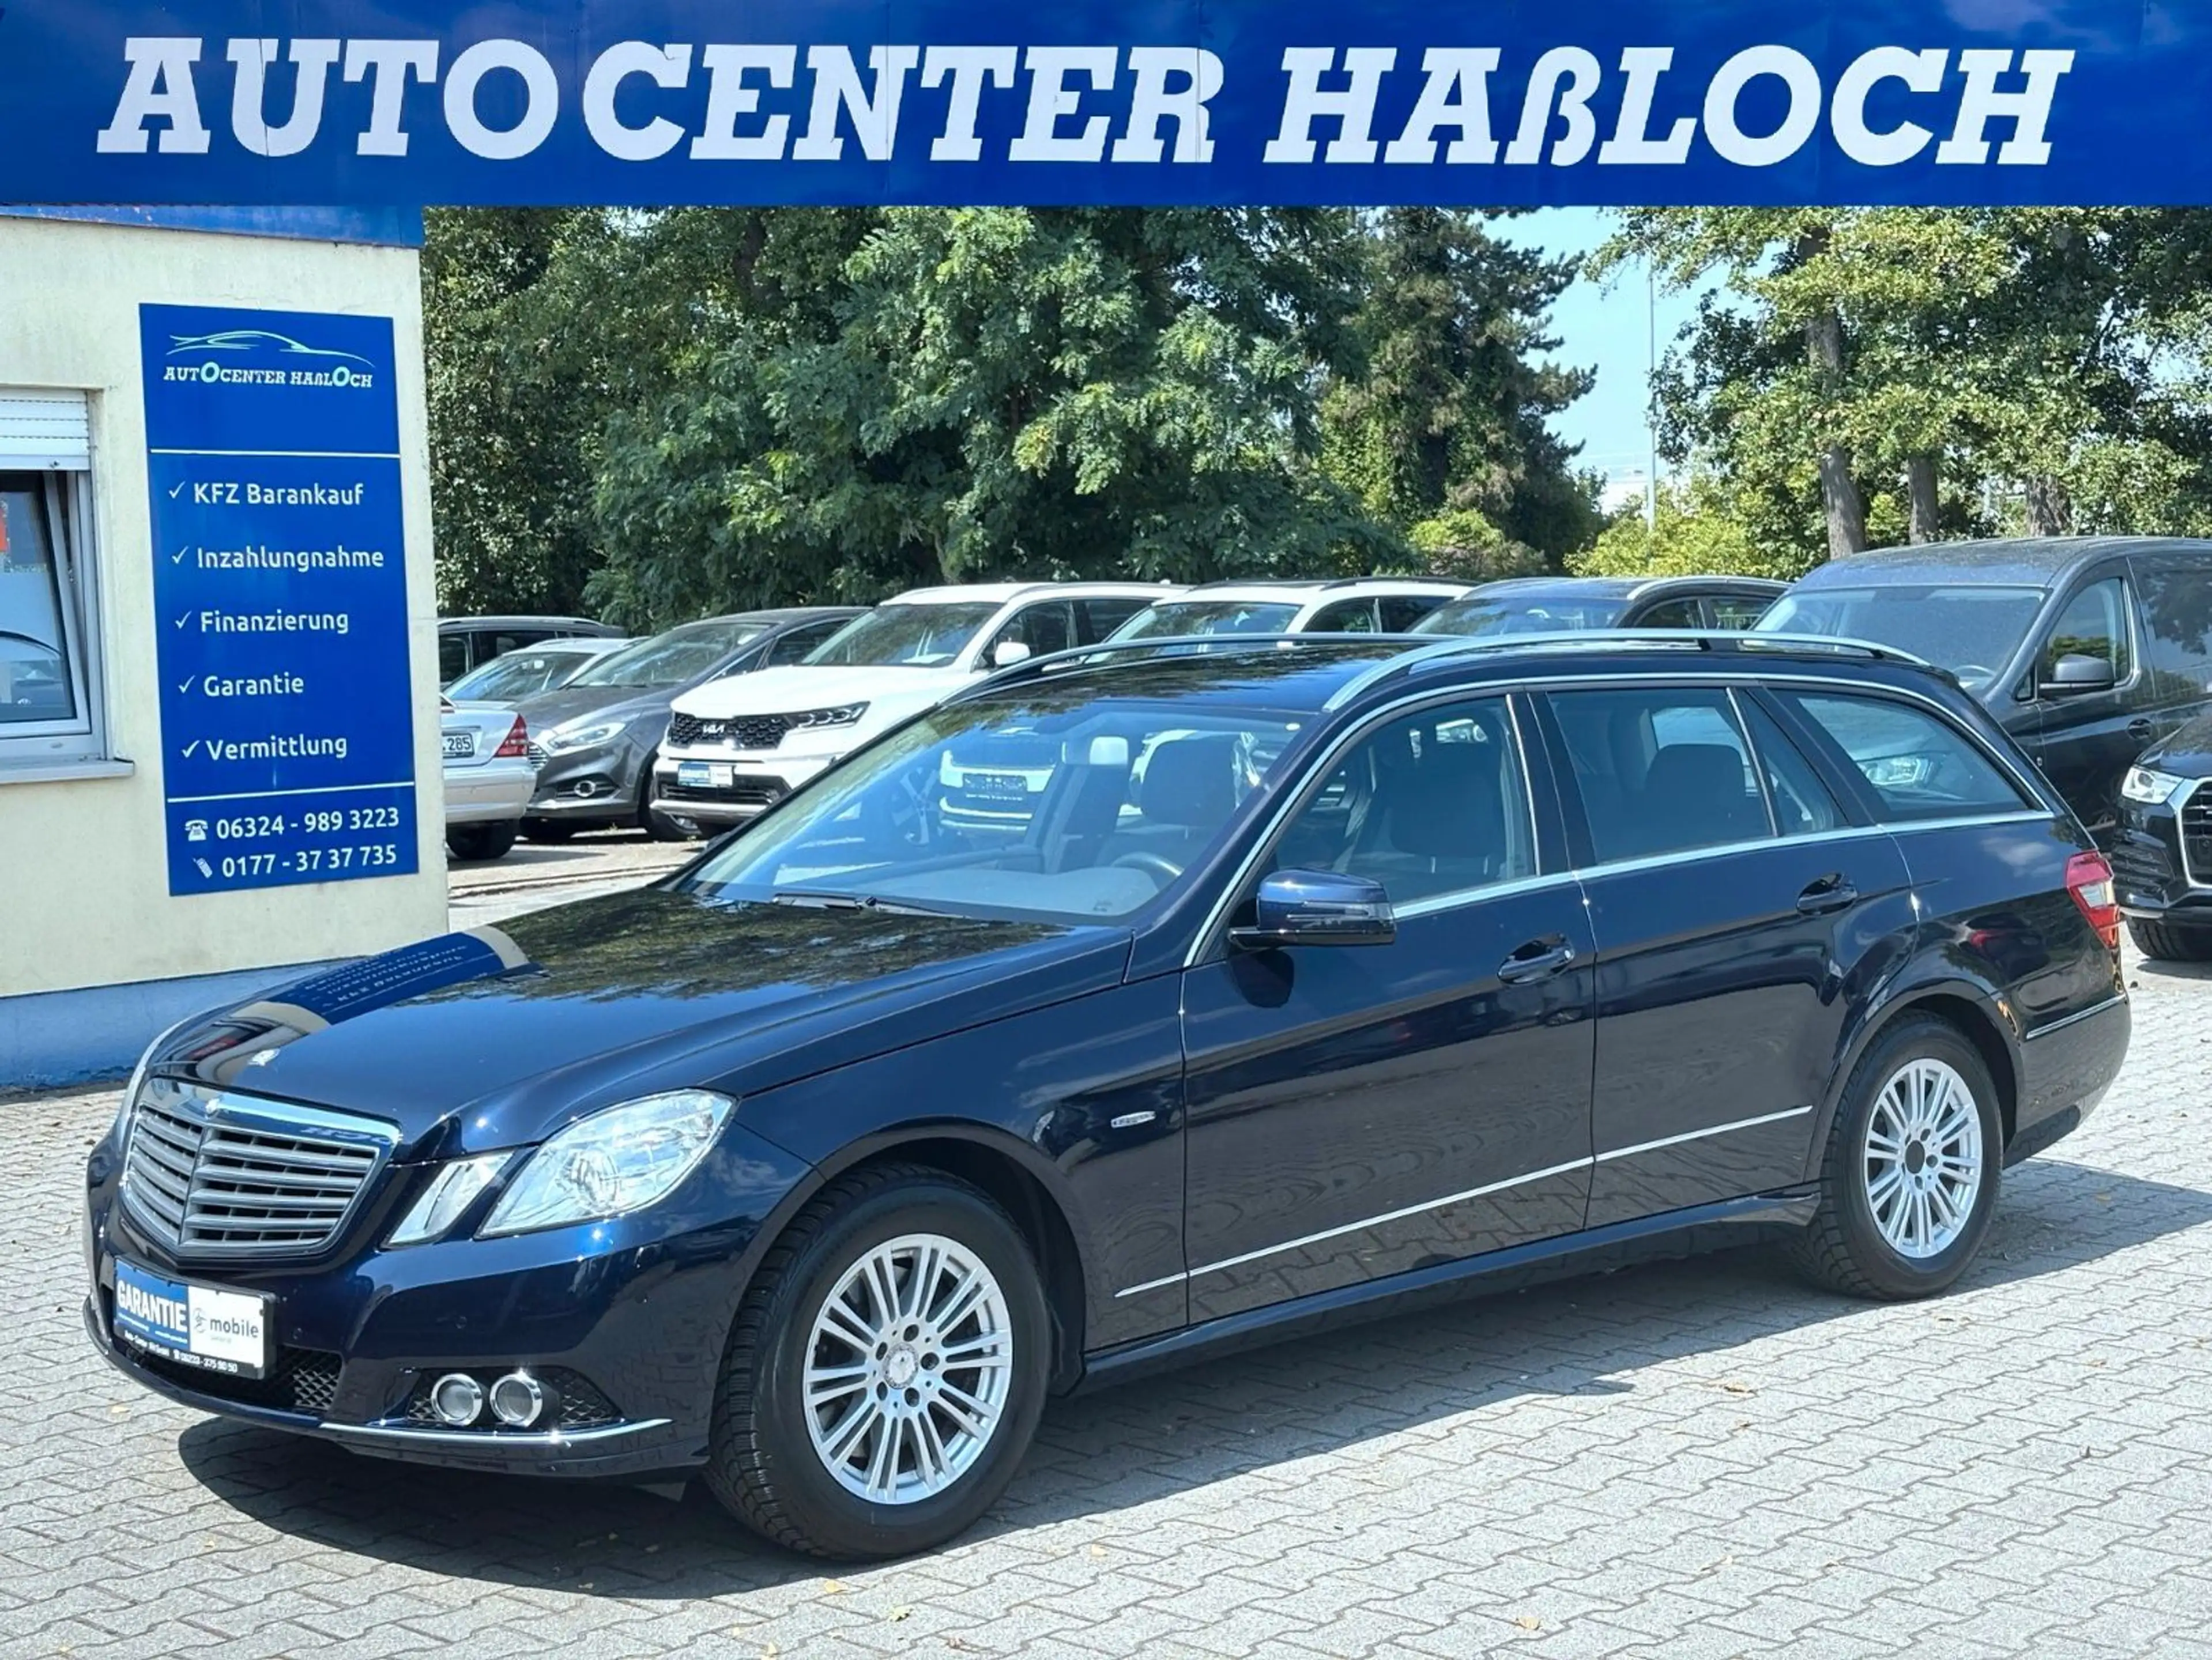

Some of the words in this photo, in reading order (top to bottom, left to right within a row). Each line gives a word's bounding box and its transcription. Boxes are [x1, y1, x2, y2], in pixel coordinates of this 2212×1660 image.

[96, 37, 1224, 163] AUTOCENTER
[1264, 44, 2076, 167] HAßLOCH
[163, 361, 287, 384] AUTOCENTER
[289, 365, 373, 388] HAßLOCH
[194, 482, 240, 504] KFZ
[247, 482, 364, 505] Barankauf
[197, 545, 385, 573] Inzahlungnahme
[200, 608, 349, 635] Finanzierung
[204, 671, 304, 697] Garantie
[205, 733, 348, 761] Vermittlung
[216, 814, 285, 840] 06324
[303, 810, 343, 833] 989
[349, 806, 400, 830] 3223
[221, 853, 276, 878] 0177
[296, 850, 322, 872] 37
[327, 847, 353, 869] 37
[359, 843, 397, 866] 735
[116, 1280, 188, 1333] GARANTIE
[209, 1316, 259, 1338] mobile
